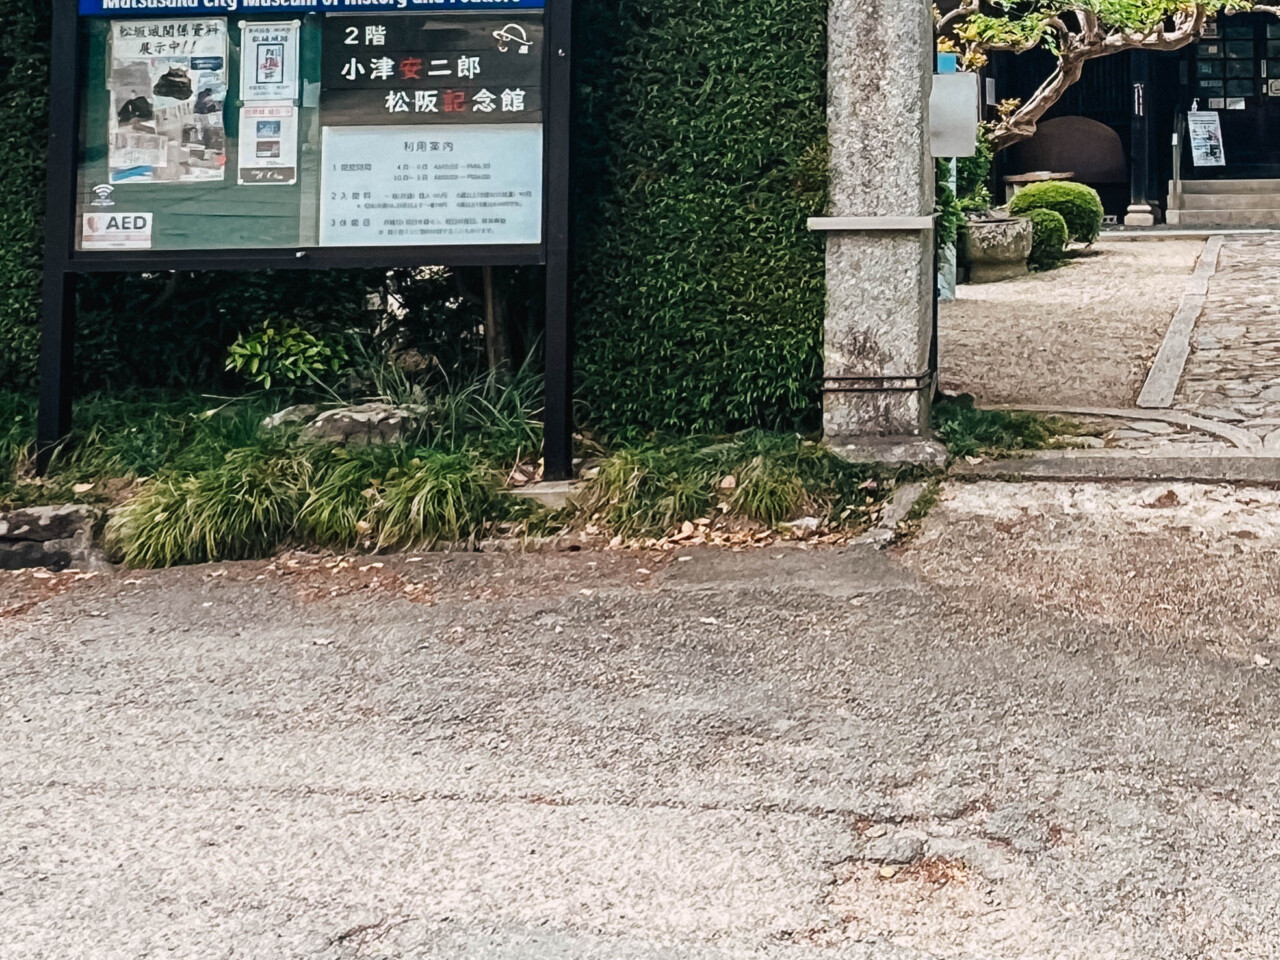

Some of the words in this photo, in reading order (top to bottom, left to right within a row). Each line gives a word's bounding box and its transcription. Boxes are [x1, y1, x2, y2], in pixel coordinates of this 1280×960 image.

[343, 25, 387, 46] 2階
[341, 56, 481, 80] 小津安二郎
[385, 88, 526, 113] 松阪記念館
[105, 216, 147, 230] AED
